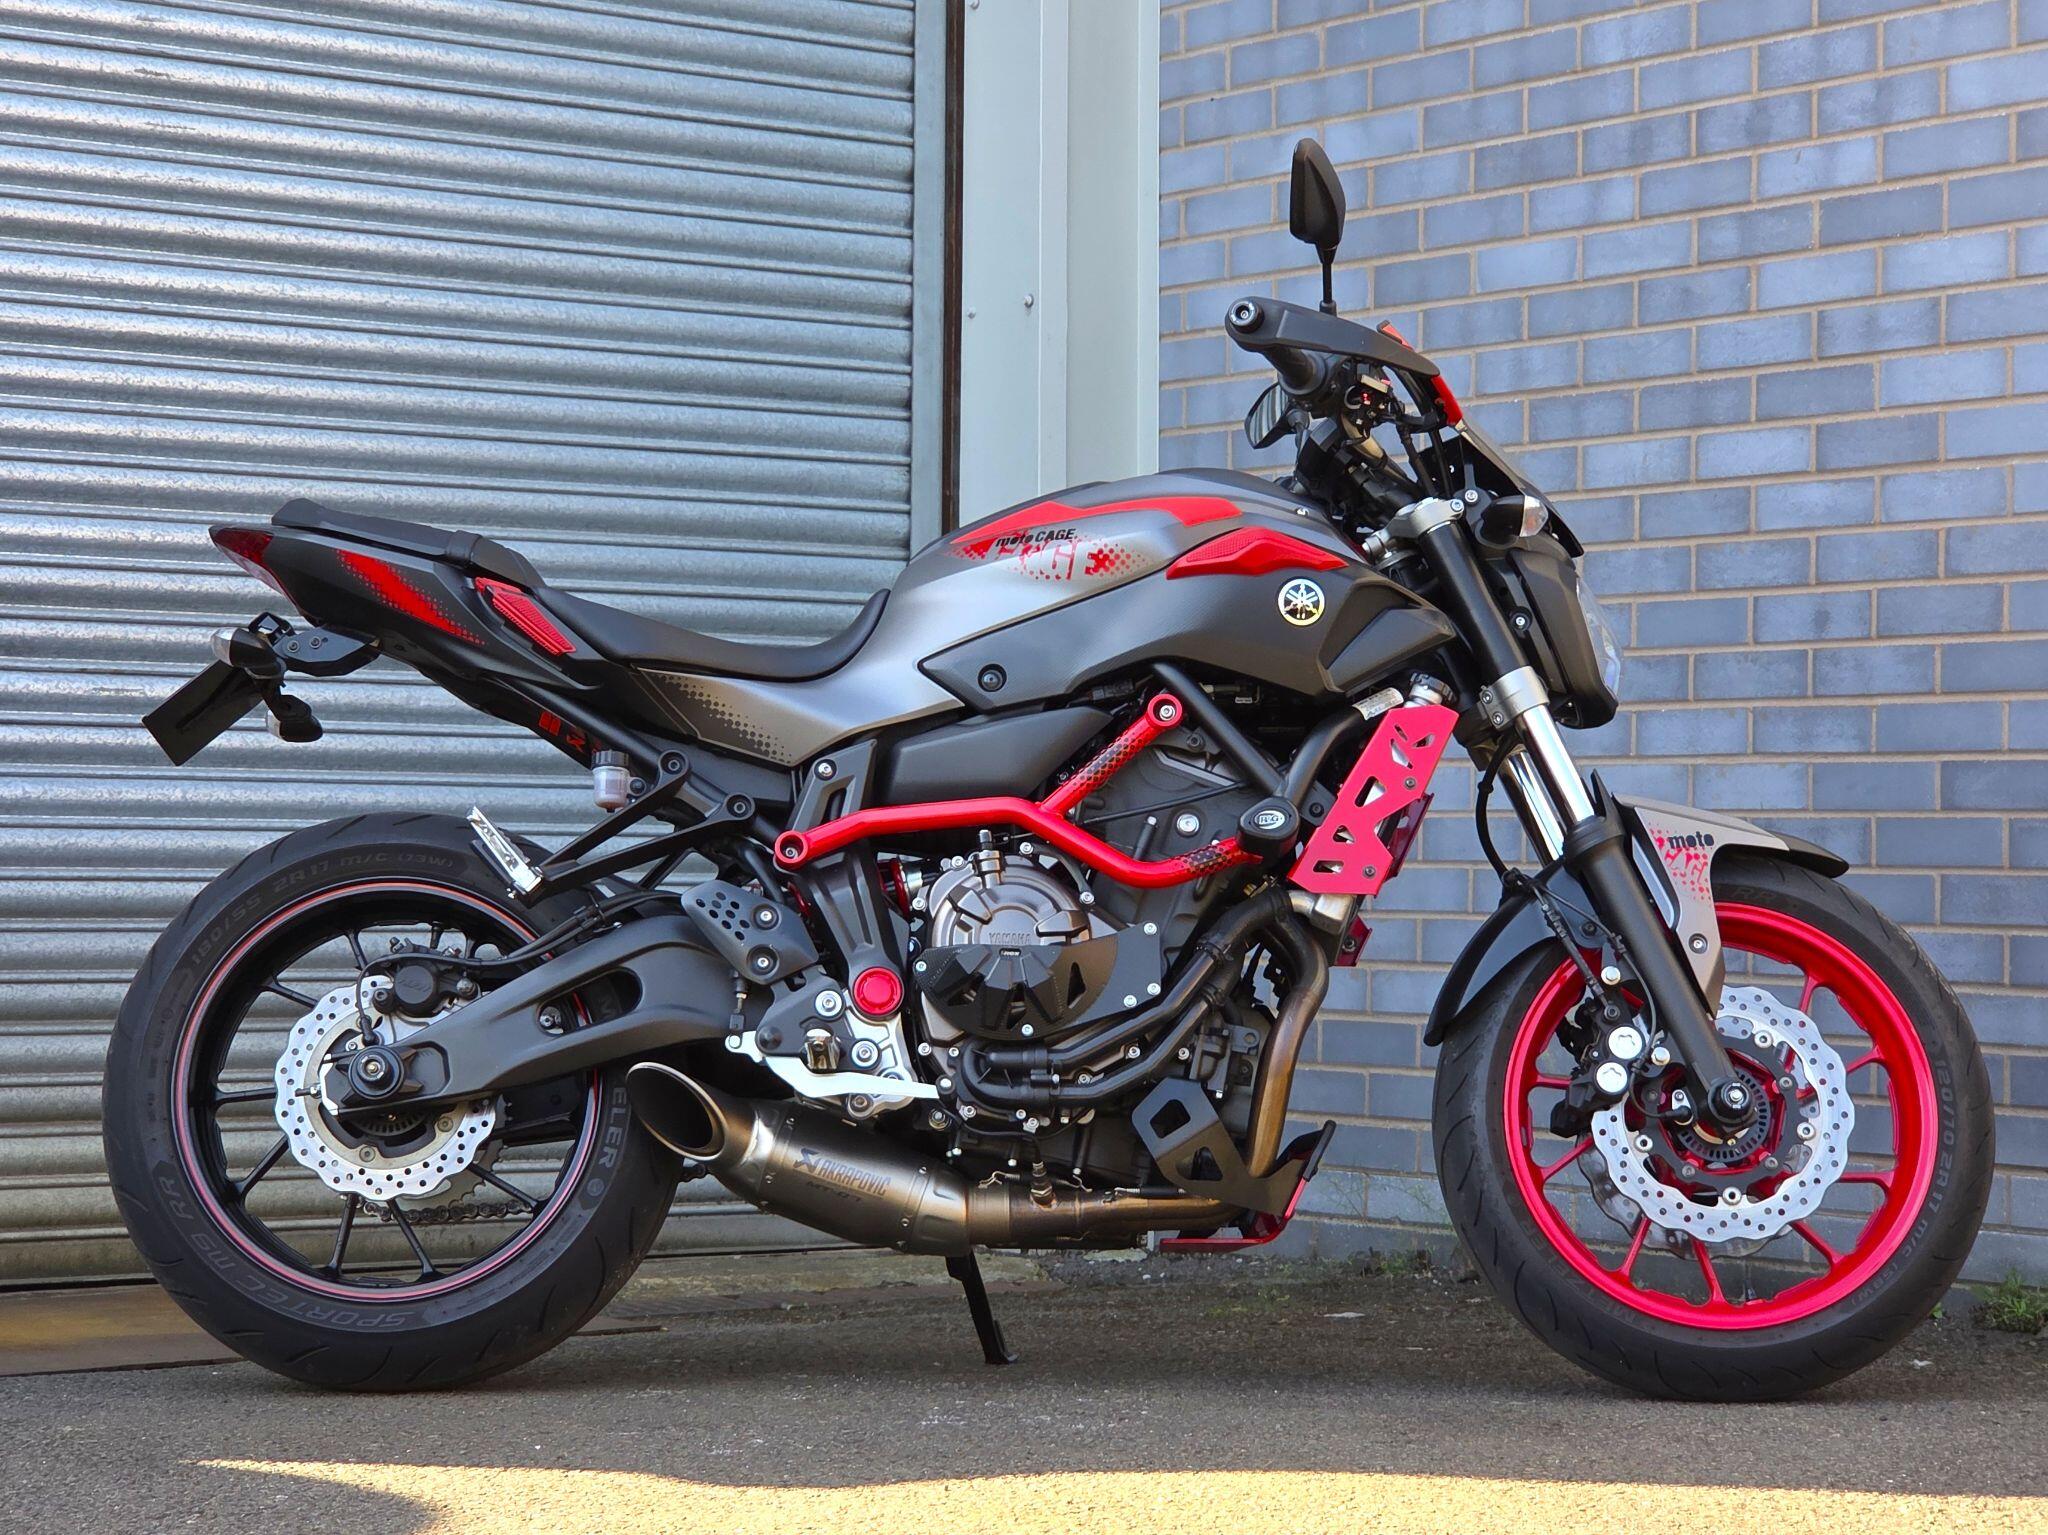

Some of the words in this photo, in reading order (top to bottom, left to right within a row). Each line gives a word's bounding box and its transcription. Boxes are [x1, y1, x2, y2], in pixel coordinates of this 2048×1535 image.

[995, 533, 1034, 547] moto
[1667, 831, 1715, 849] moto
[237, 1274, 415, 1328] SPORTEC
